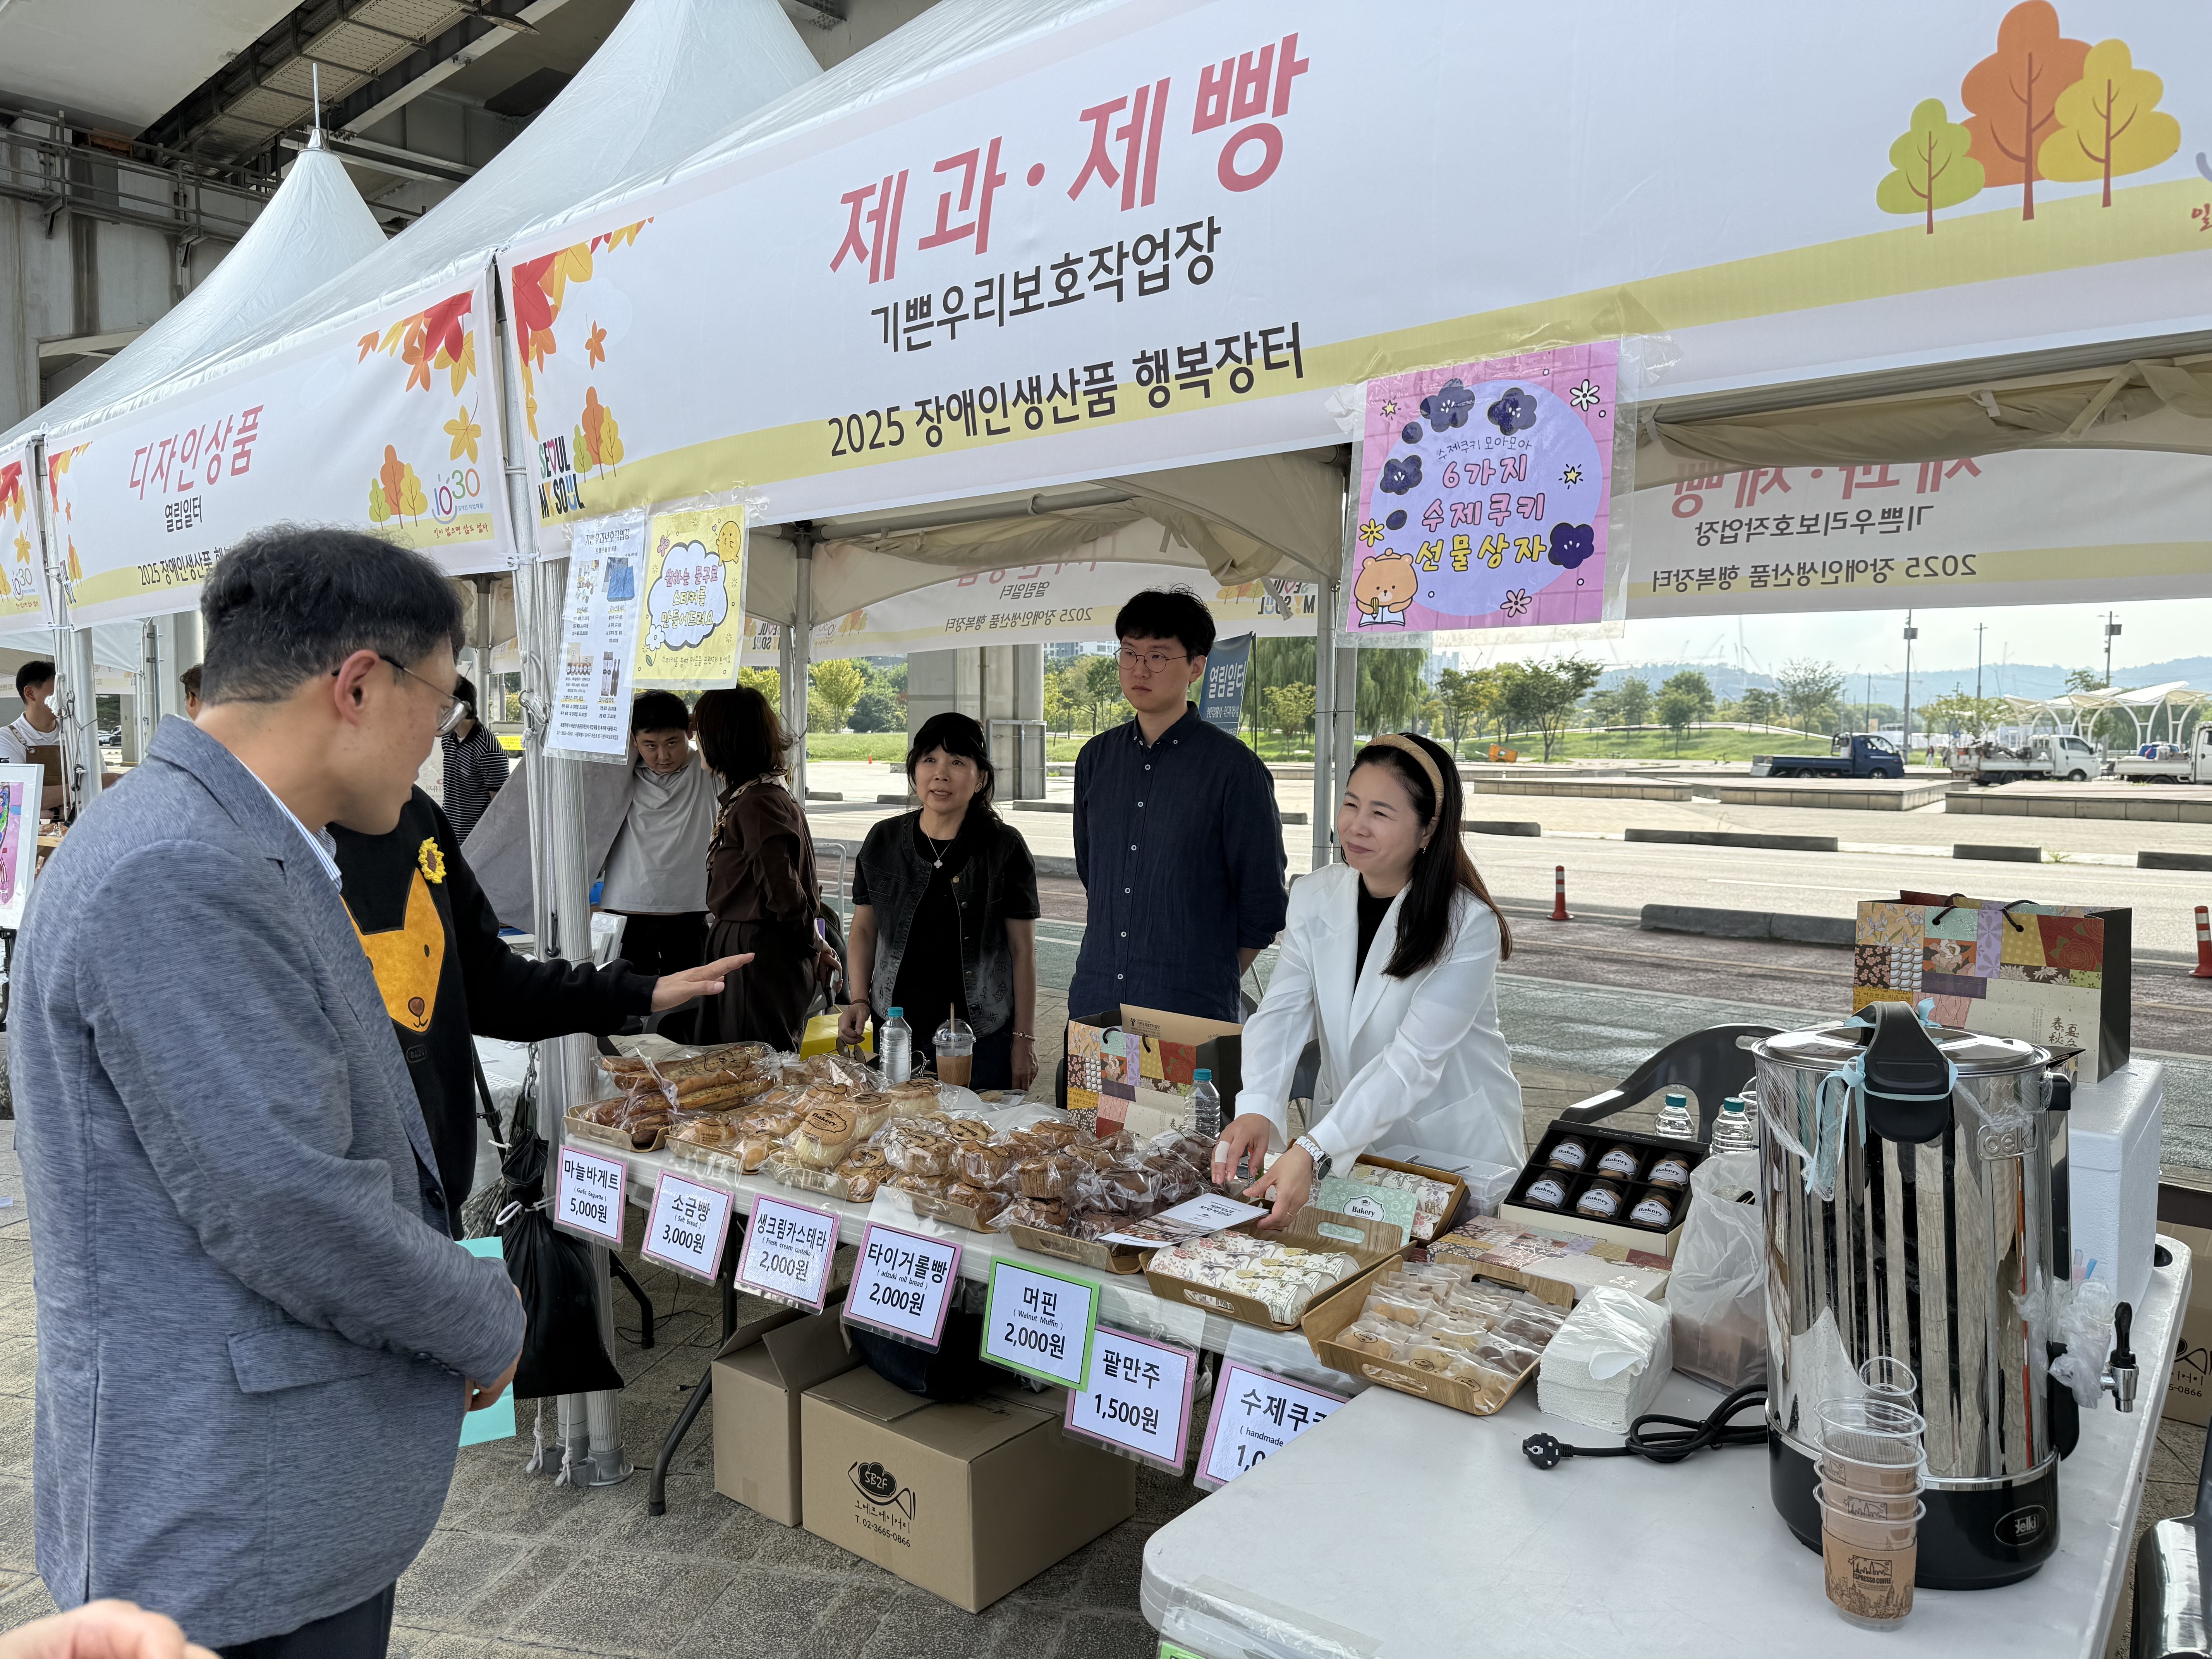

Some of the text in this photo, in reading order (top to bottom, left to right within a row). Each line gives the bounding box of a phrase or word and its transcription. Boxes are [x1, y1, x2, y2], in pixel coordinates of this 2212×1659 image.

[830, 33, 1309, 283] 제과·제빵
[2191, 203, 2212, 232] 일
[871, 216, 1221, 352] 기쁜우리보호작업장
[828, 322, 1304, 457] 2025 장애인생산품 행복장터
[129, 404, 264, 500] 디자인상품
[1439, 436, 1532, 459] 수제쿠키 모아모아
[1442, 453, 1528, 489] 6가지
[553, 473, 585, 514] SOUL
[165, 495, 202, 532] 열림일터
[1421, 493, 1545, 532] 수제쿠키
[445, 526, 461, 537] 없으면
[463, 524, 474, 535] 삶도
[477, 523, 488, 533] 없다
[1415, 532, 1547, 572] 선물상자
[138, 563, 160, 585] 2025
[160, 551, 213, 585] 장애인생산품
[665, 565, 718, 587] 원하는 문구로
[673, 586, 706, 606] 스티커를
[661, 609, 713, 629] 만들어드려요
[662, 656, 678, 667] 스티커를
[1209, 661, 1246, 699] 열림일터
[812, 1113, 837, 1126] Bakery
[1558, 1149, 1581, 1160] Bakery
[1605, 1157, 1627, 1166] Bakery
[564, 1160, 618, 1190] 마늘바게트
[1656, 1168, 1680, 1176] Bakery
[1534, 1186, 1558, 1197] Bakery
[1585, 1195, 1609, 1206] Bakery
[570, 1197, 607, 1224] 5,000원
[672, 1195, 710, 1222] 소금빵
[687, 1219, 698, 1227] Bread
[1352, 1206, 1376, 1217] Bakery
[1638, 1207, 1664, 1216] Bakery
[662, 1224, 706, 1254] 3,000원
[758, 1213, 826, 1252] 생크림카스테라
[766, 1238, 778, 1246] Fresh
[795, 1248, 811, 1256] castella
[759, 1251, 809, 1282] 2,000원
[868, 1243, 947, 1283] 타이거롤빵
[881, 1271, 897, 1279] adzuki
[909, 1278, 924, 1288] bread
[869, 1283, 925, 1316] 2,000원
[1024, 1287, 1057, 1317] 머핀
[1018, 1310, 1037, 1322] Walnut
[1040, 1317, 1058, 1328] Muffin
[1004, 1322, 1065, 1360] 2,000원
[1103, 1349, 1160, 1389] 팥만주
[1095, 1394, 1159, 1435] 1,500원
[1246, 1427, 1284, 1447] handmade
[855, 1515, 910, 1547] T. 02-3665-0866
[1853, 1573, 1875, 1583] ESPRESSO
